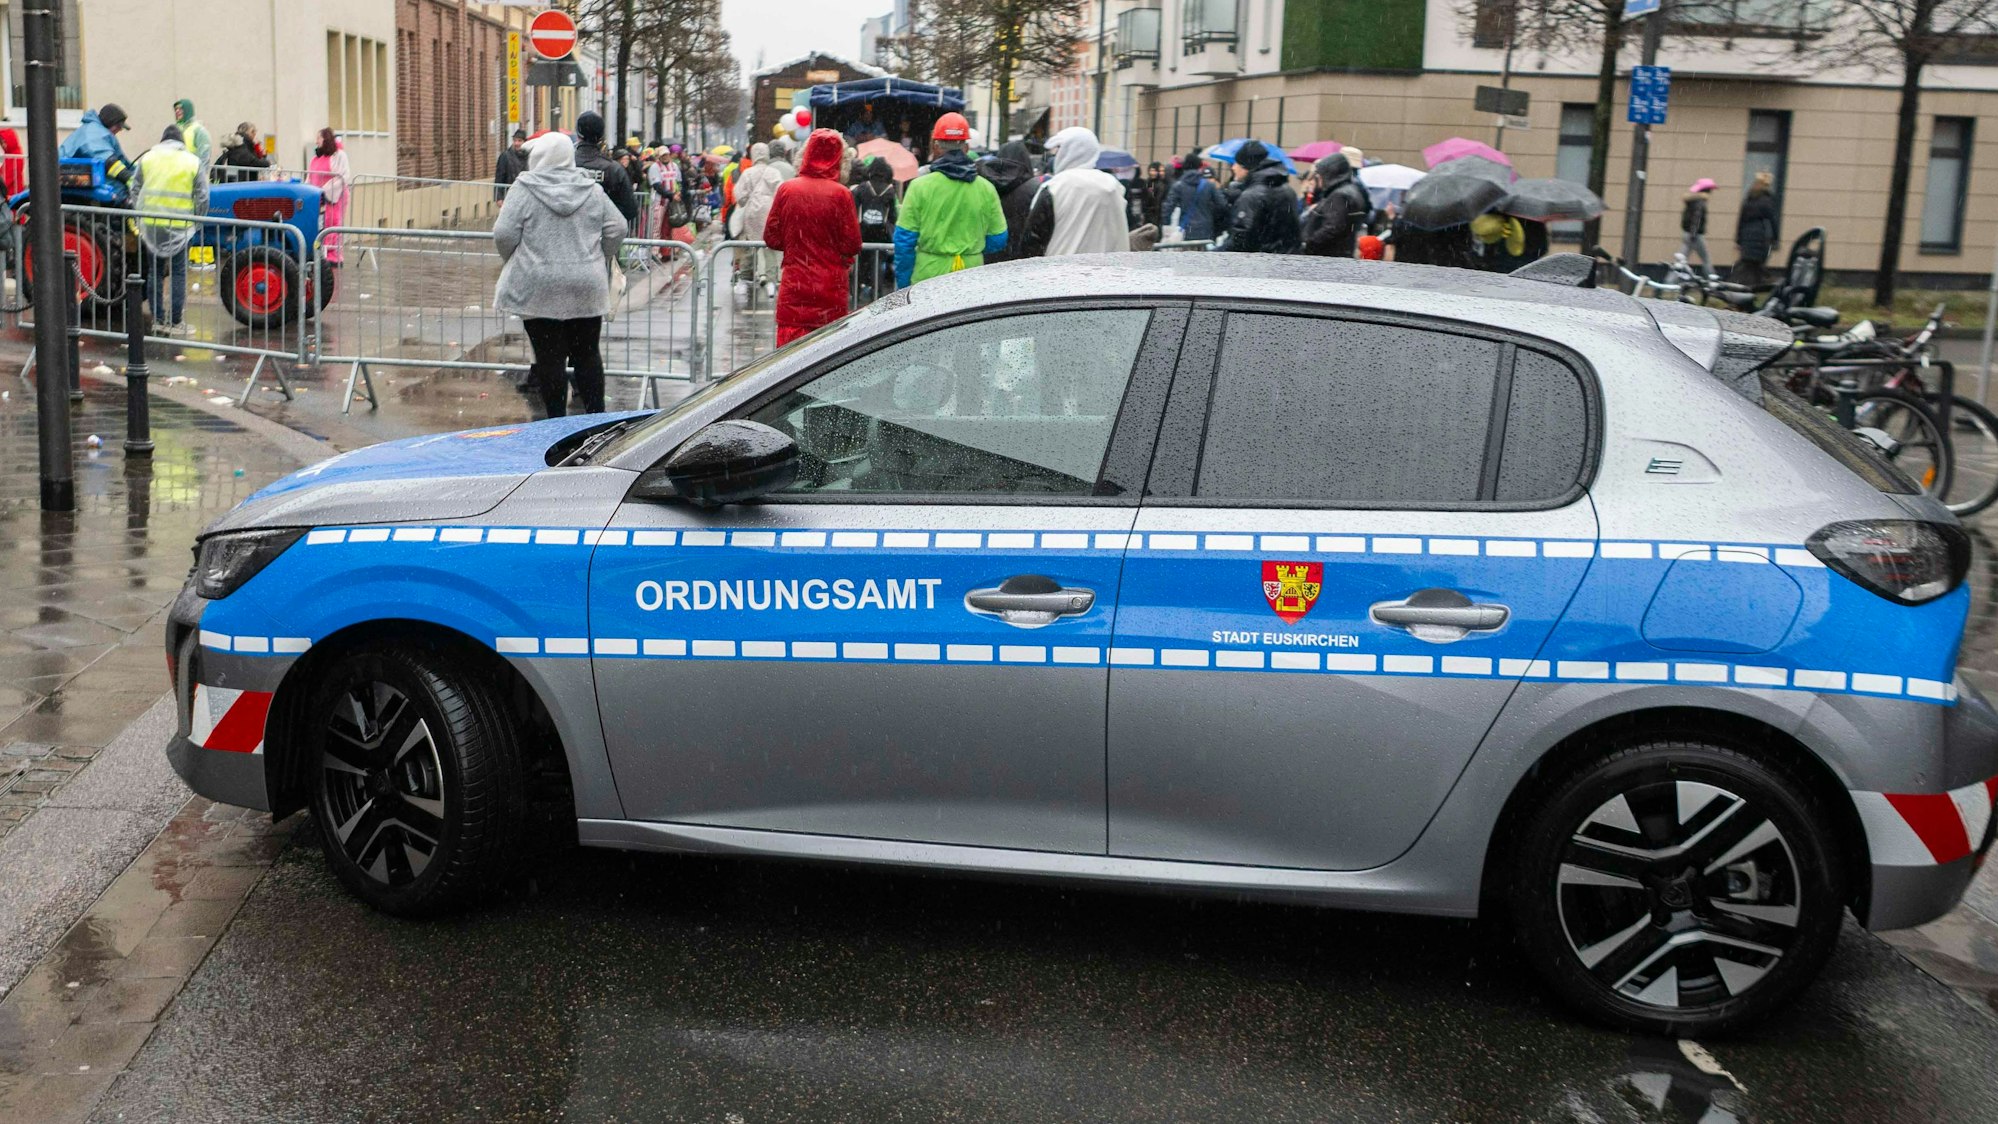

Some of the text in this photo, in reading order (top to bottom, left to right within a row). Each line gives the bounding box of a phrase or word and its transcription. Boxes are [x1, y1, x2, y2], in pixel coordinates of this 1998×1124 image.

[510, 34, 518, 119] KINDERKRAM
[635, 578, 942, 611] ORDNUNGSAMT
[1212, 630, 1360, 648] STADT EUSKIRCHEN
